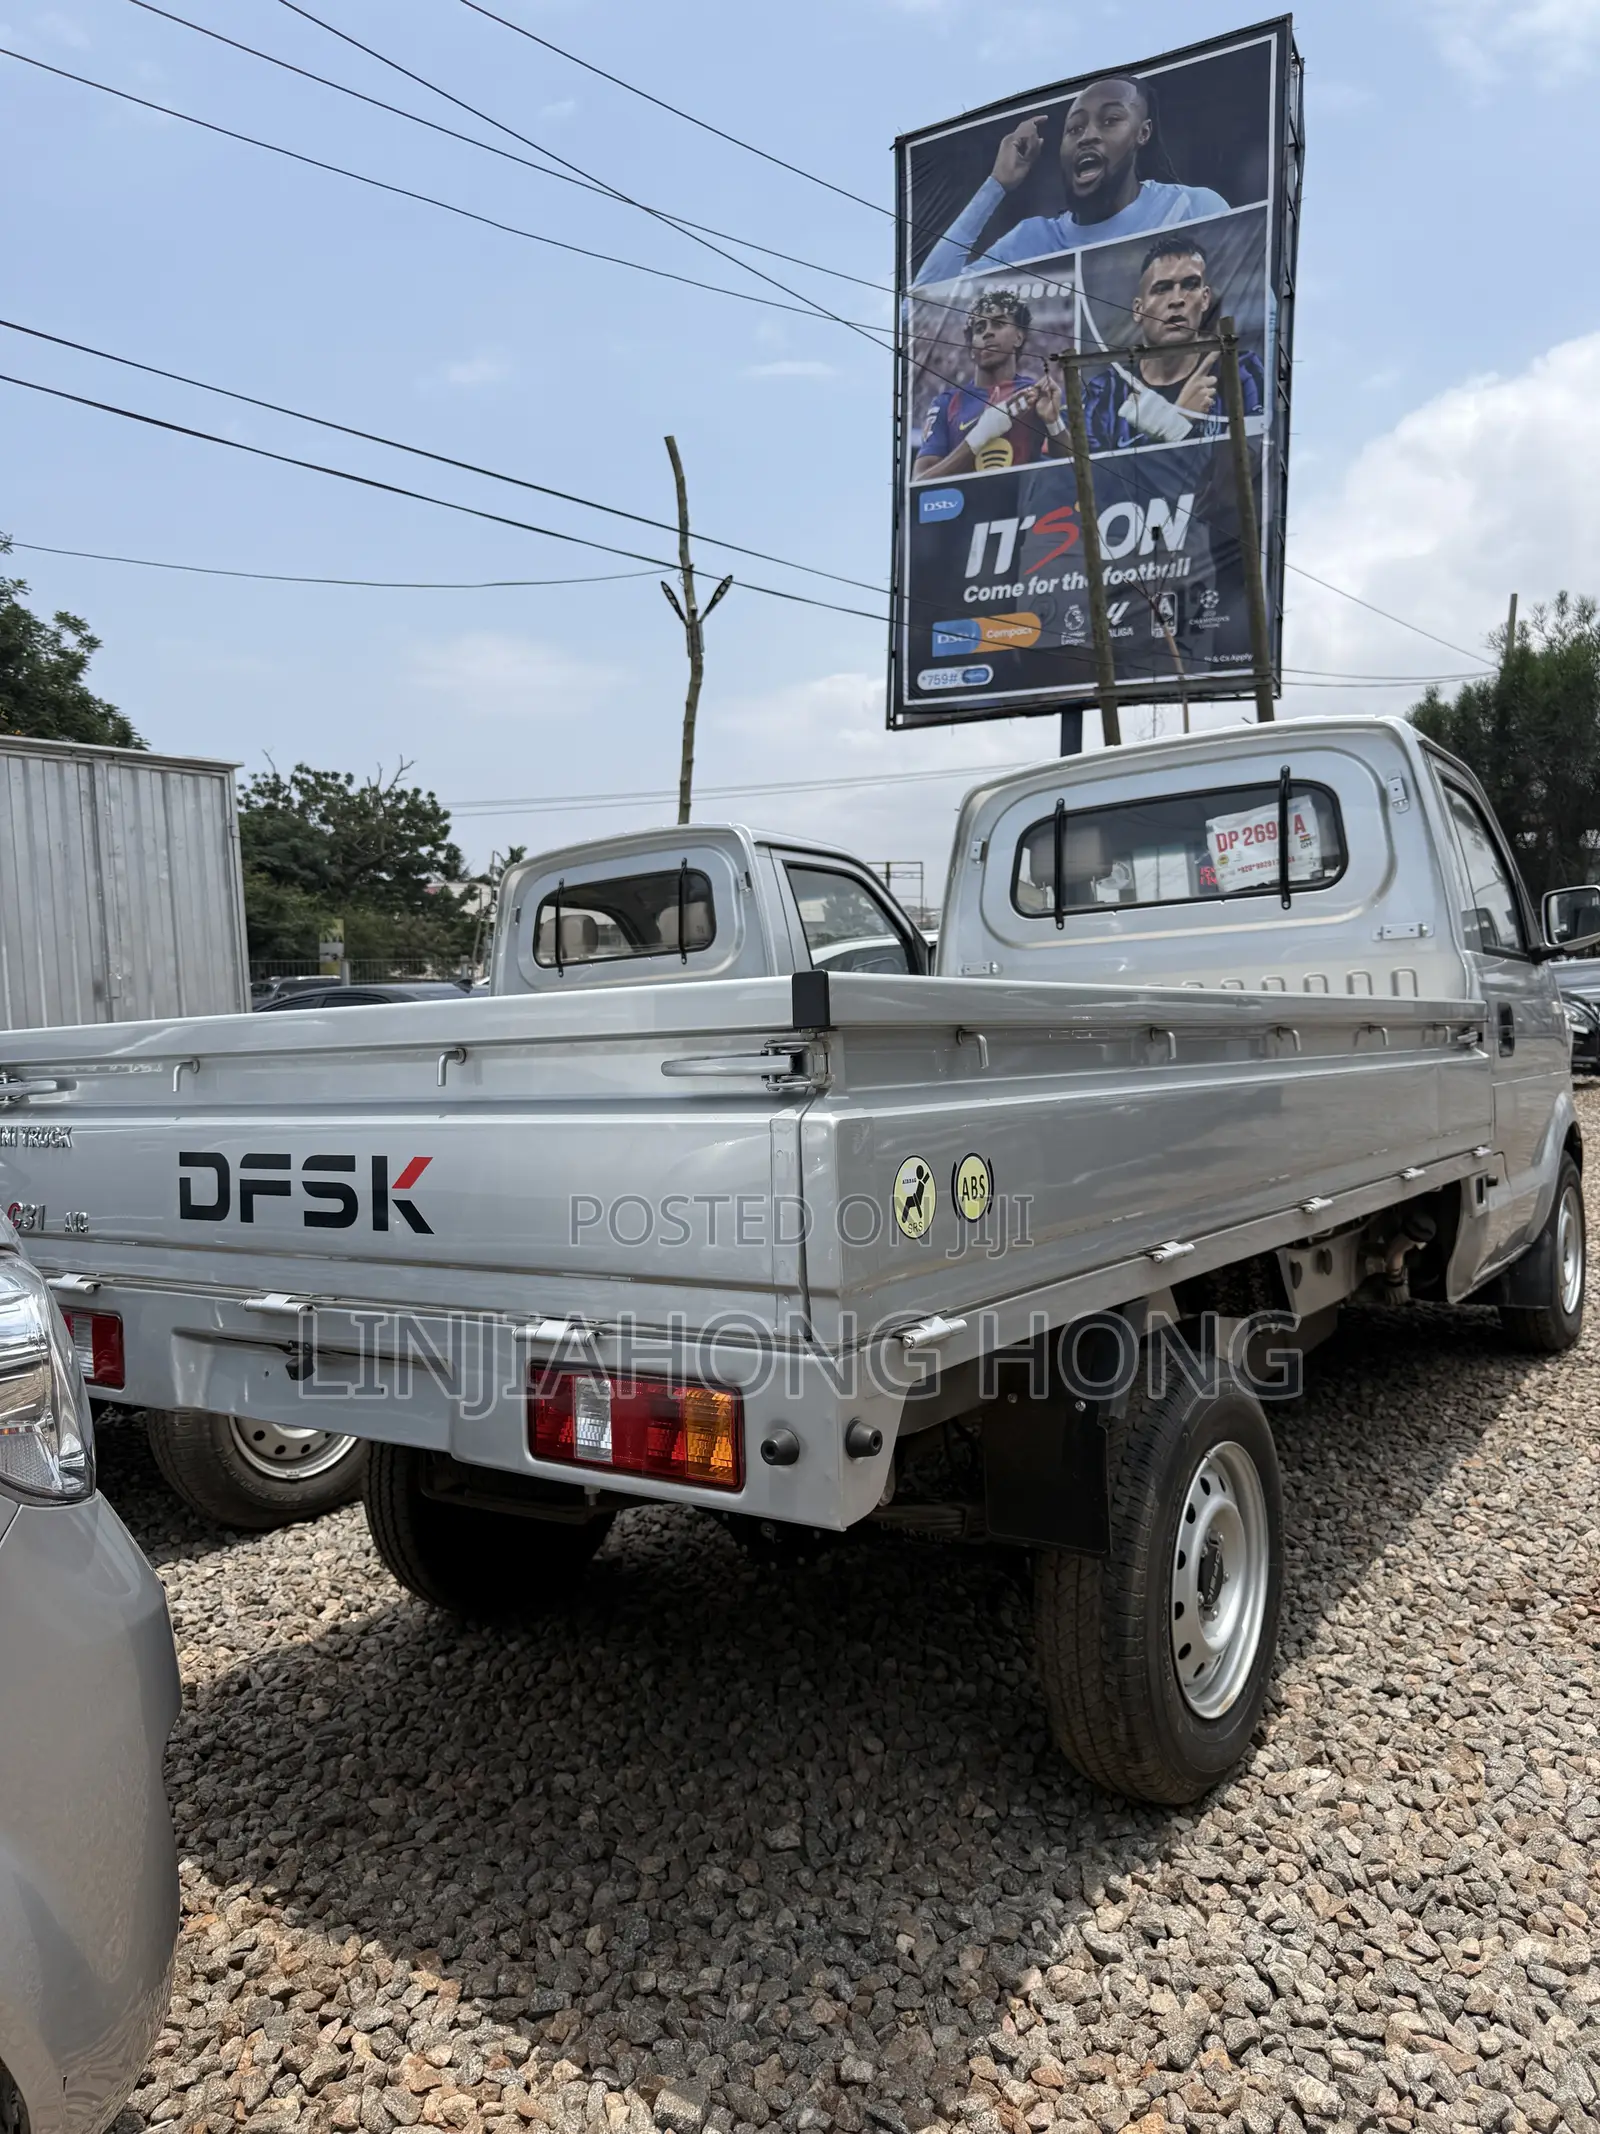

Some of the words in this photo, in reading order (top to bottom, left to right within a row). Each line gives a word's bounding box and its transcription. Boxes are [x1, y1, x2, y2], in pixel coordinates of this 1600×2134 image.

[923, 501, 958, 512] DStv
[964, 506, 1079, 579] IT'S
[1096, 493, 1195, 560] ON
[963, 583, 1025, 603] Come
[1028, 576, 1060, 596] for
[986, 627, 1033, 639] Compact
[1215, 830, 1239, 853] DP
[1242, 821, 1279, 847] 269
[20, 1126, 73, 1149] TRUCK
[179, 1151, 435, 1235] DFSK
[962, 1174, 986, 1202] ABS
[908, 1221, 924, 1234] SRS
